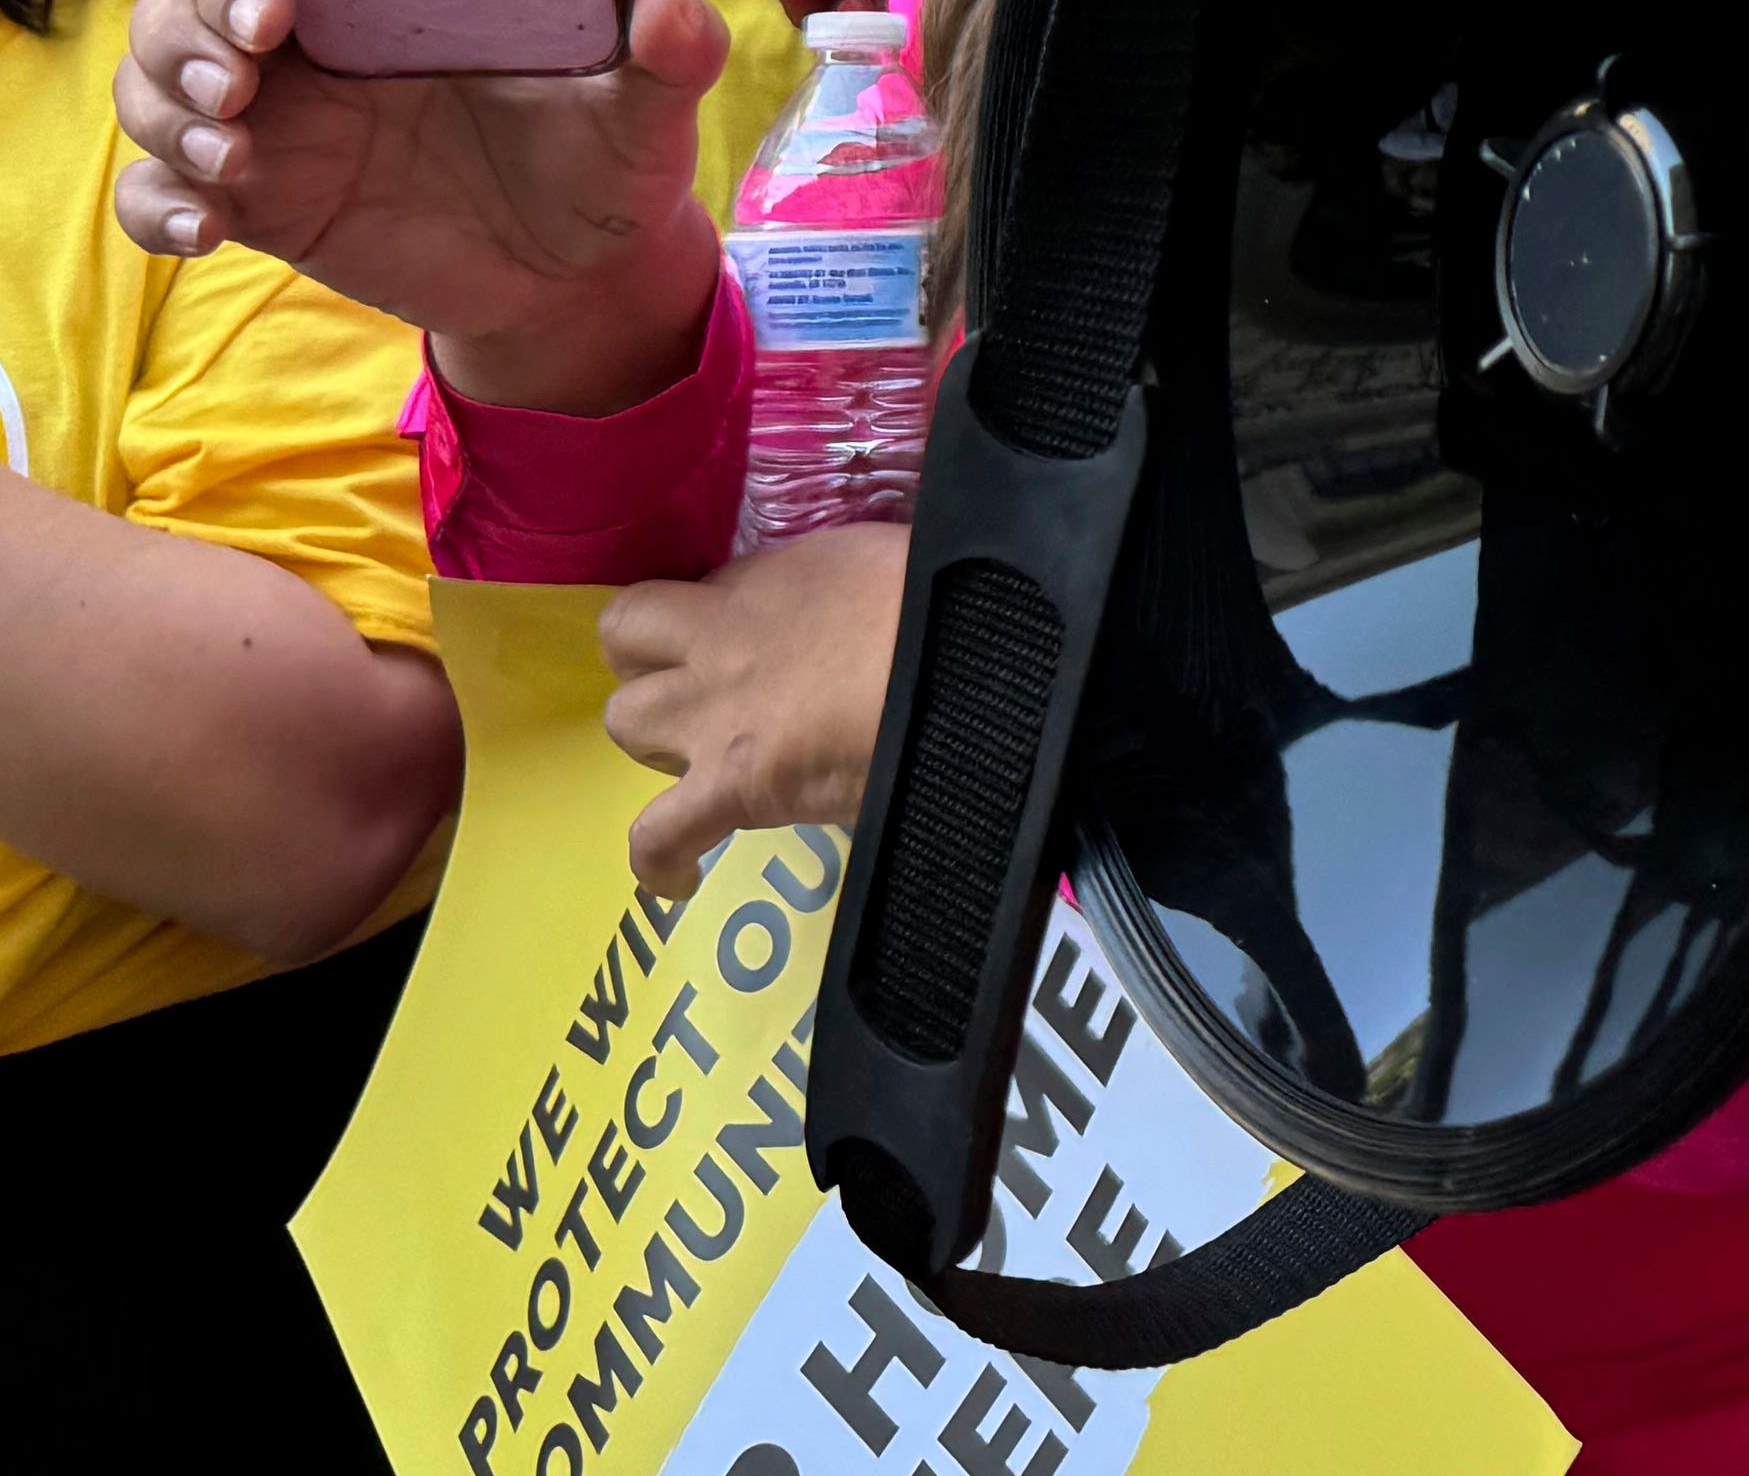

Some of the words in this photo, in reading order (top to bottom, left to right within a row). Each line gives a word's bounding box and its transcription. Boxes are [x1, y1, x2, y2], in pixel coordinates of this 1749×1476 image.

[458, 981, 720, 1476] PROTECT
[478, 1064, 579, 1251] WE
[565, 834, 736, 1065] WIL
[800, 932, 1138, 1457] HME
